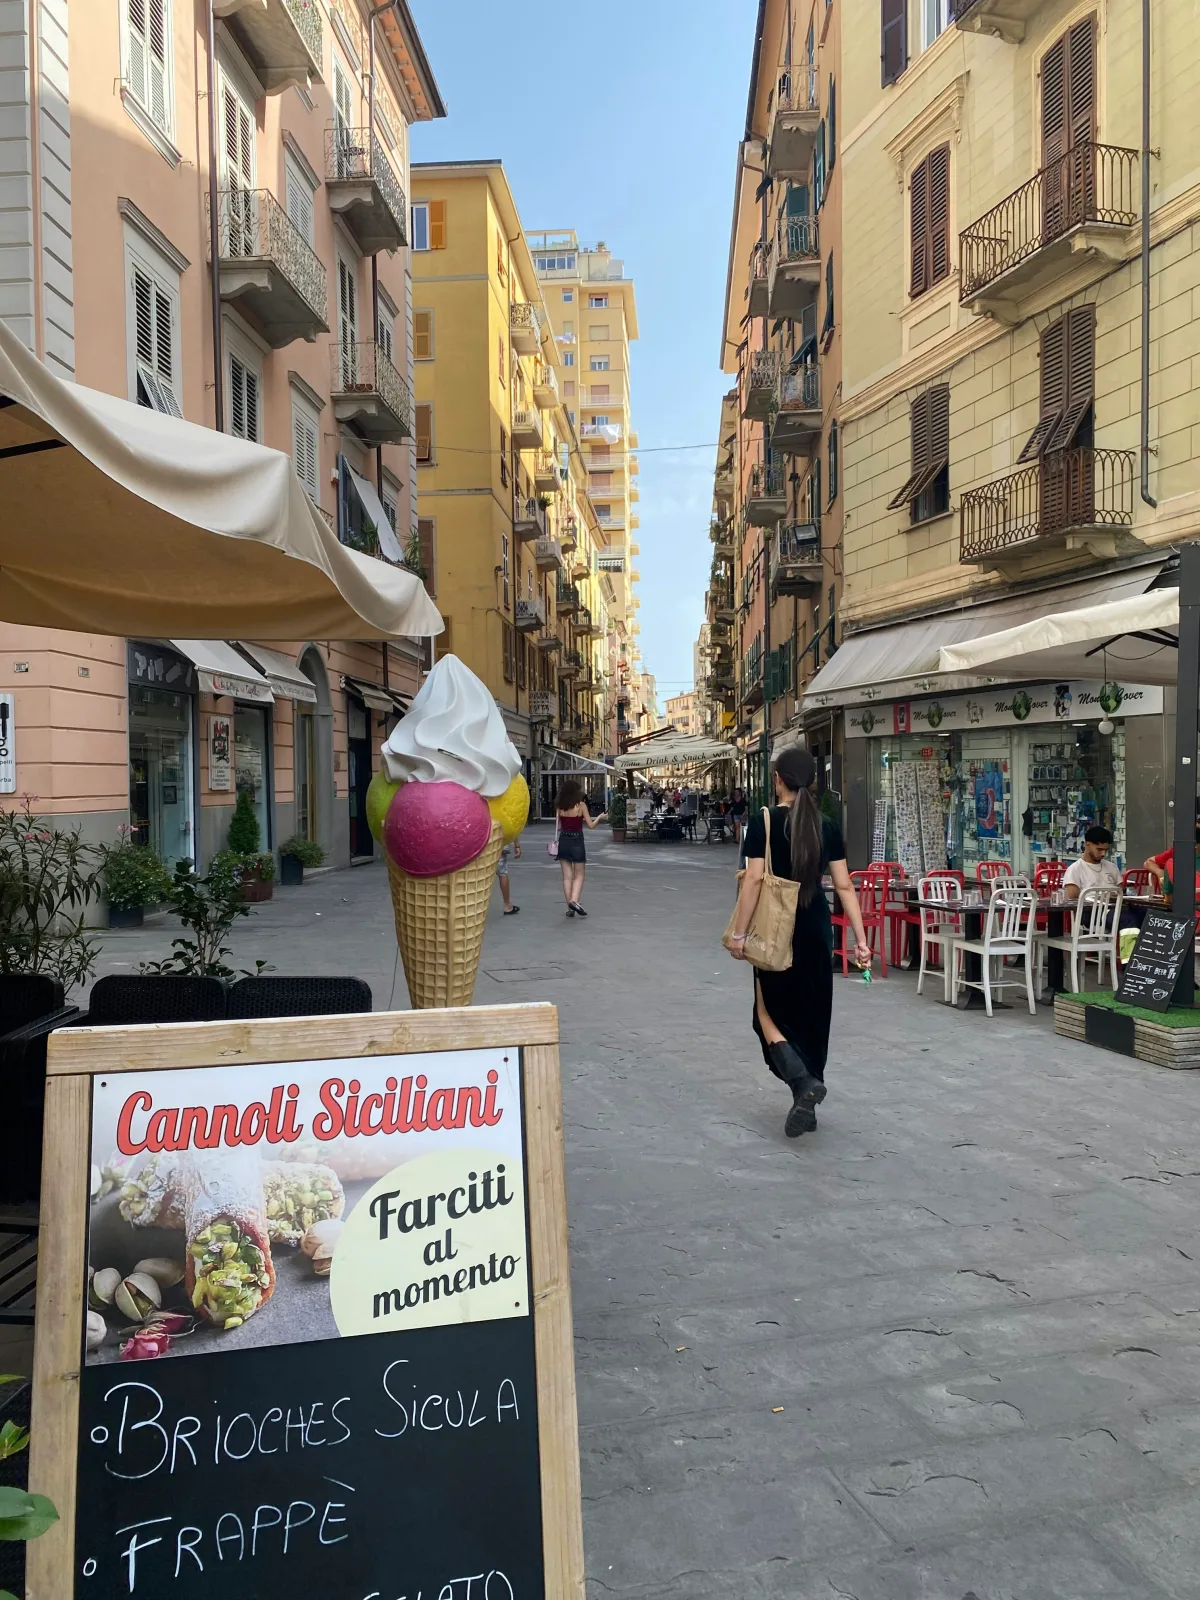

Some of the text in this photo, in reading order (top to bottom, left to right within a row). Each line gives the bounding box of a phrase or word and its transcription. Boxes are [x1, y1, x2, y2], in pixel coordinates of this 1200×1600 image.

[994, 701, 1022, 712] Mondo
[1078, 688, 1144, 704] Mondo Cover
[646, 755, 669, 765] Drink
[682, 752, 706, 762] Snack
[116, 1069, 503, 1155] Cannoli Siciliani
[369, 1163, 514, 1240] Farciti
[423, 1228, 458, 1266] al
[373, 1252, 521, 1319] momento
[116, 1476, 355, 1593] FRAPPÈ
